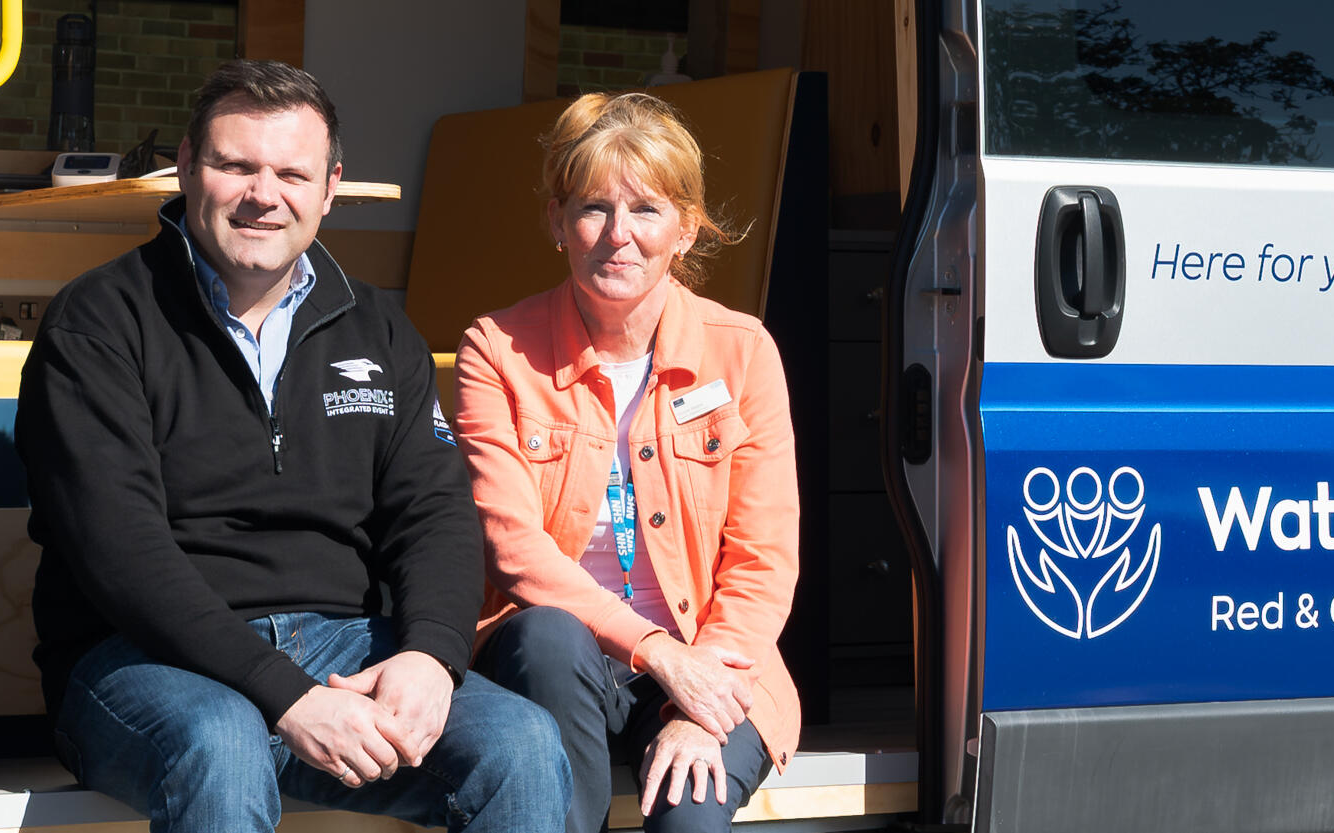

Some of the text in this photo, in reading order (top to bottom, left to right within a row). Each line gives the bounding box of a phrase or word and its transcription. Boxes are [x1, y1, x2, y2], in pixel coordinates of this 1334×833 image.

[1151, 243, 1245, 281] Here
[1258, 243, 1313, 282] for
[323, 388, 388, 406] PHOENIX
[327, 406, 371, 416] INTEGRATED
[611, 500, 624, 524] NHS
[615, 532, 627, 556] NHS
[1211, 593, 1284, 631] Red
[1295, 593, 1319, 628] &
